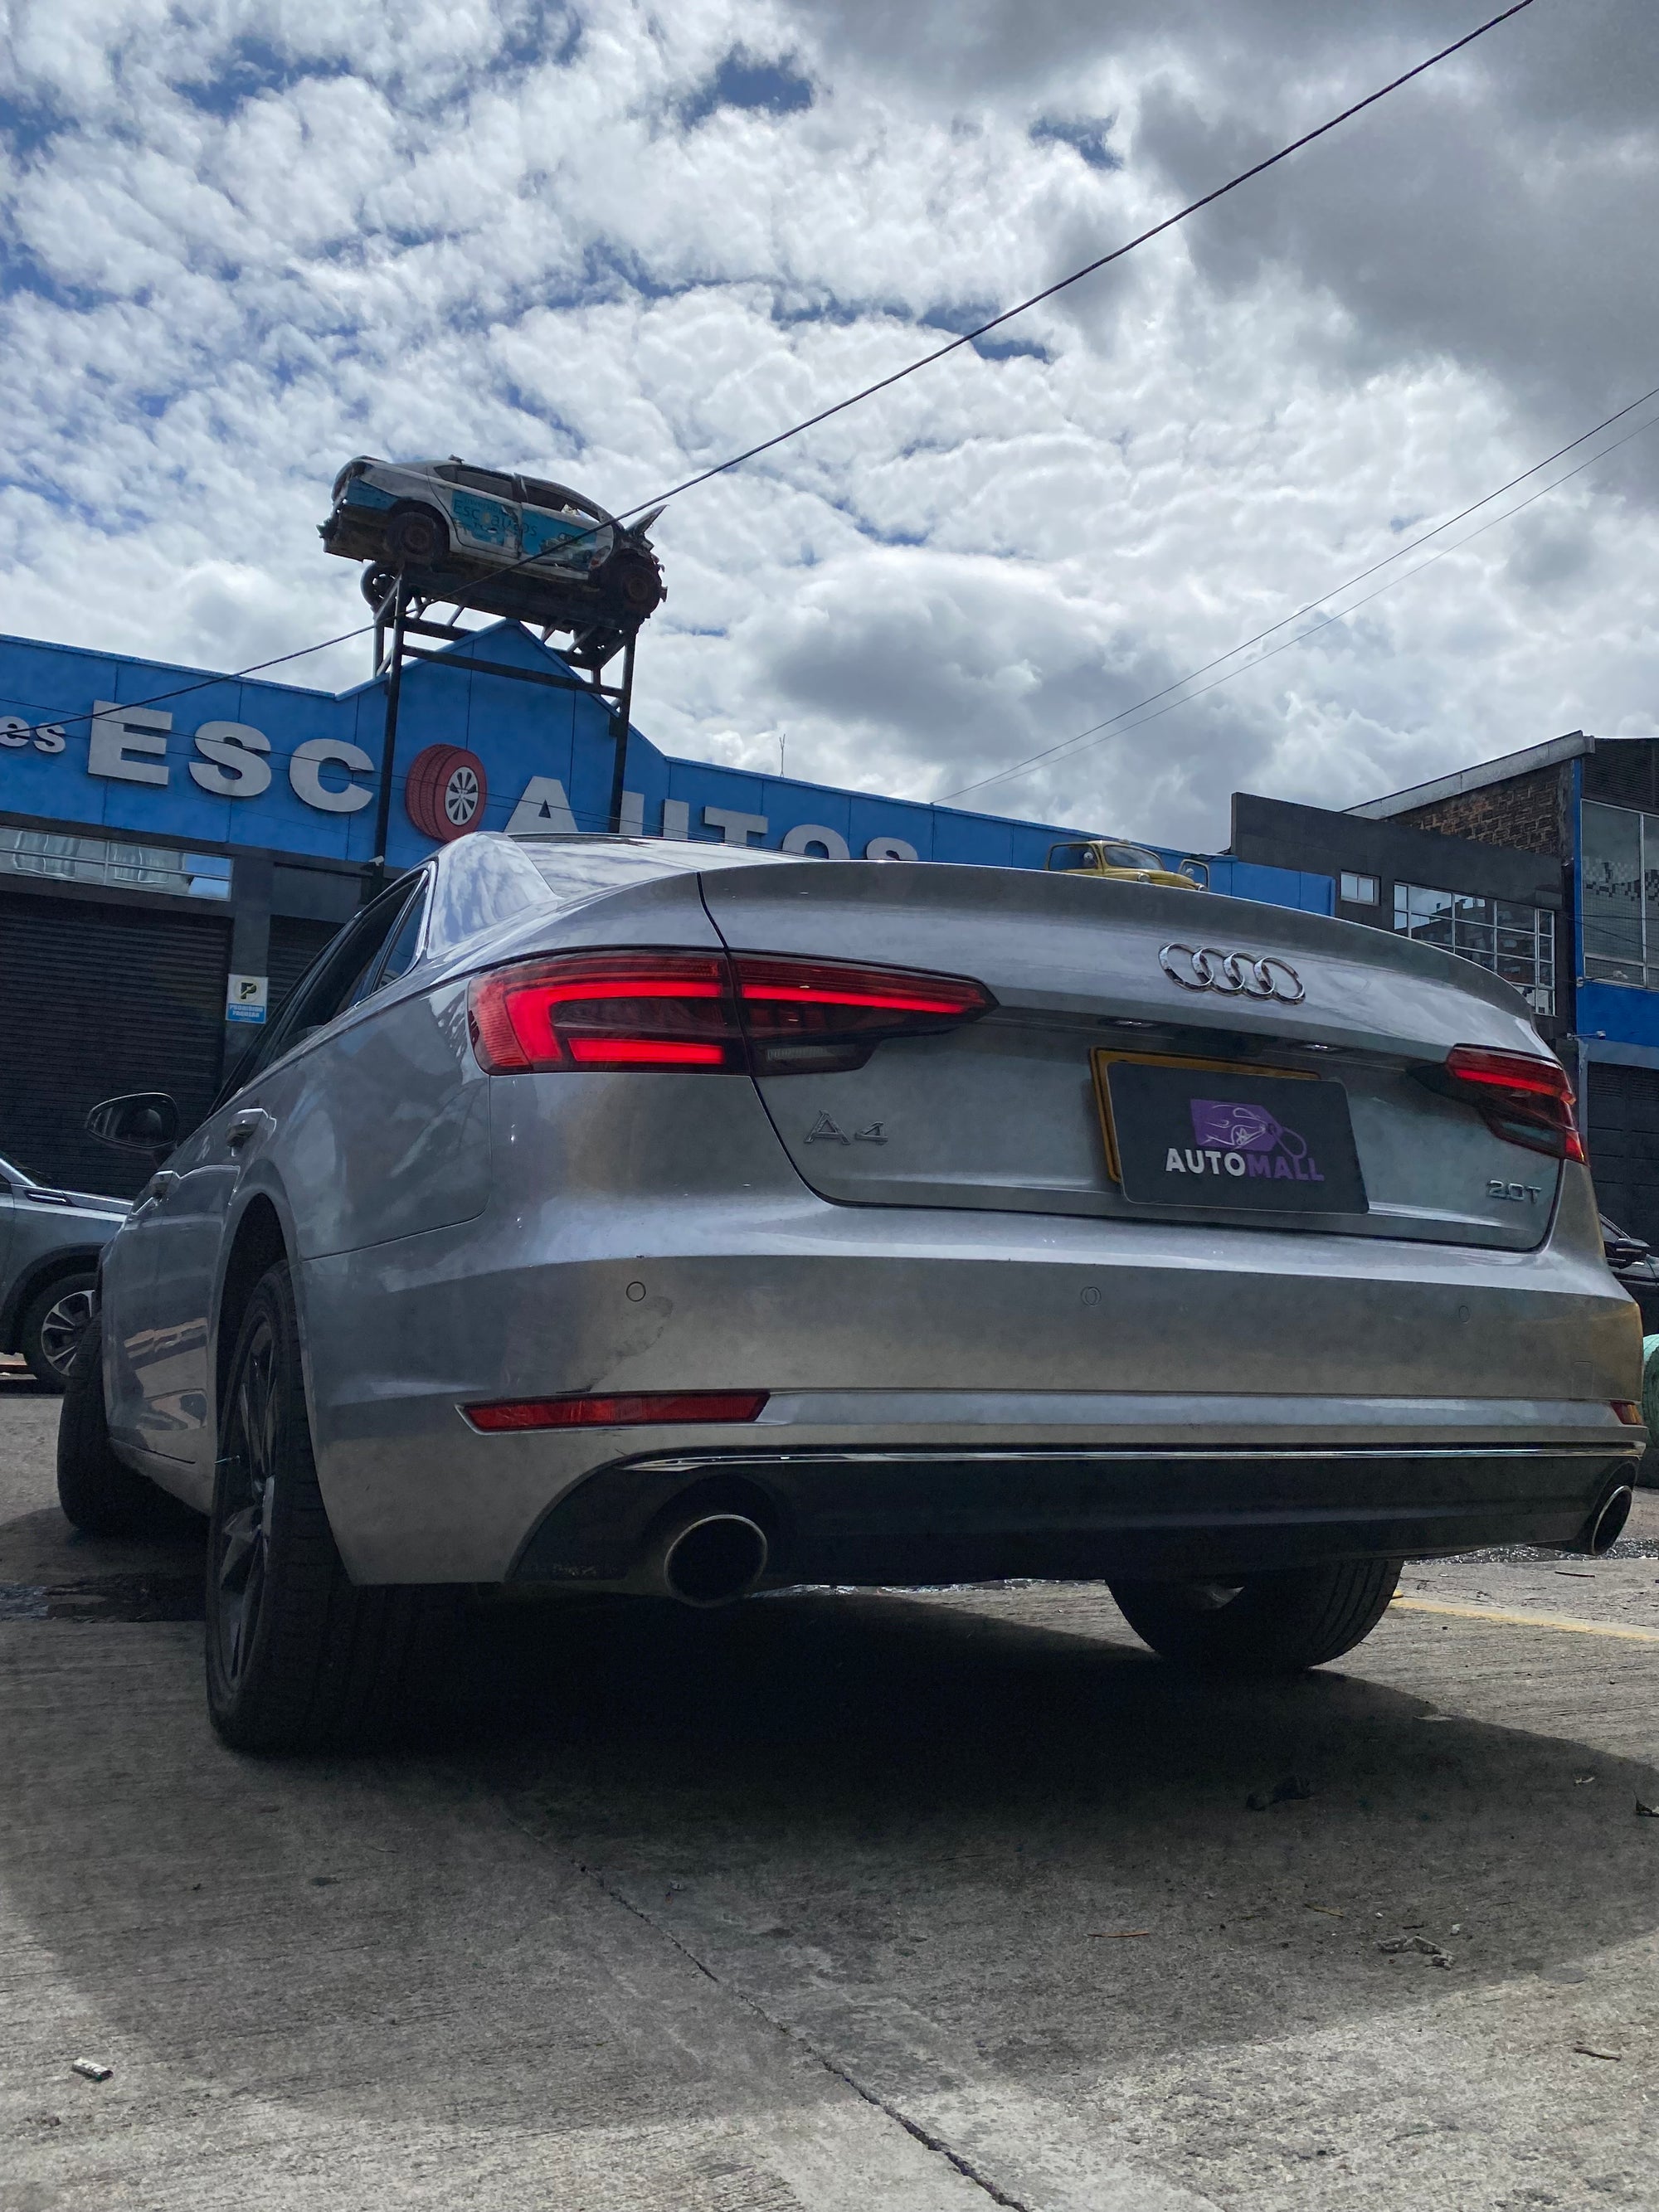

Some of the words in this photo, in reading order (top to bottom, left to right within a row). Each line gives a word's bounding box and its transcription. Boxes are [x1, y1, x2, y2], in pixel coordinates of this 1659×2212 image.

[241, 982, 257, 1000] P
[803, 1110, 888, 1145] A4
[1165, 1148, 1325, 1182] AUTOMALL
